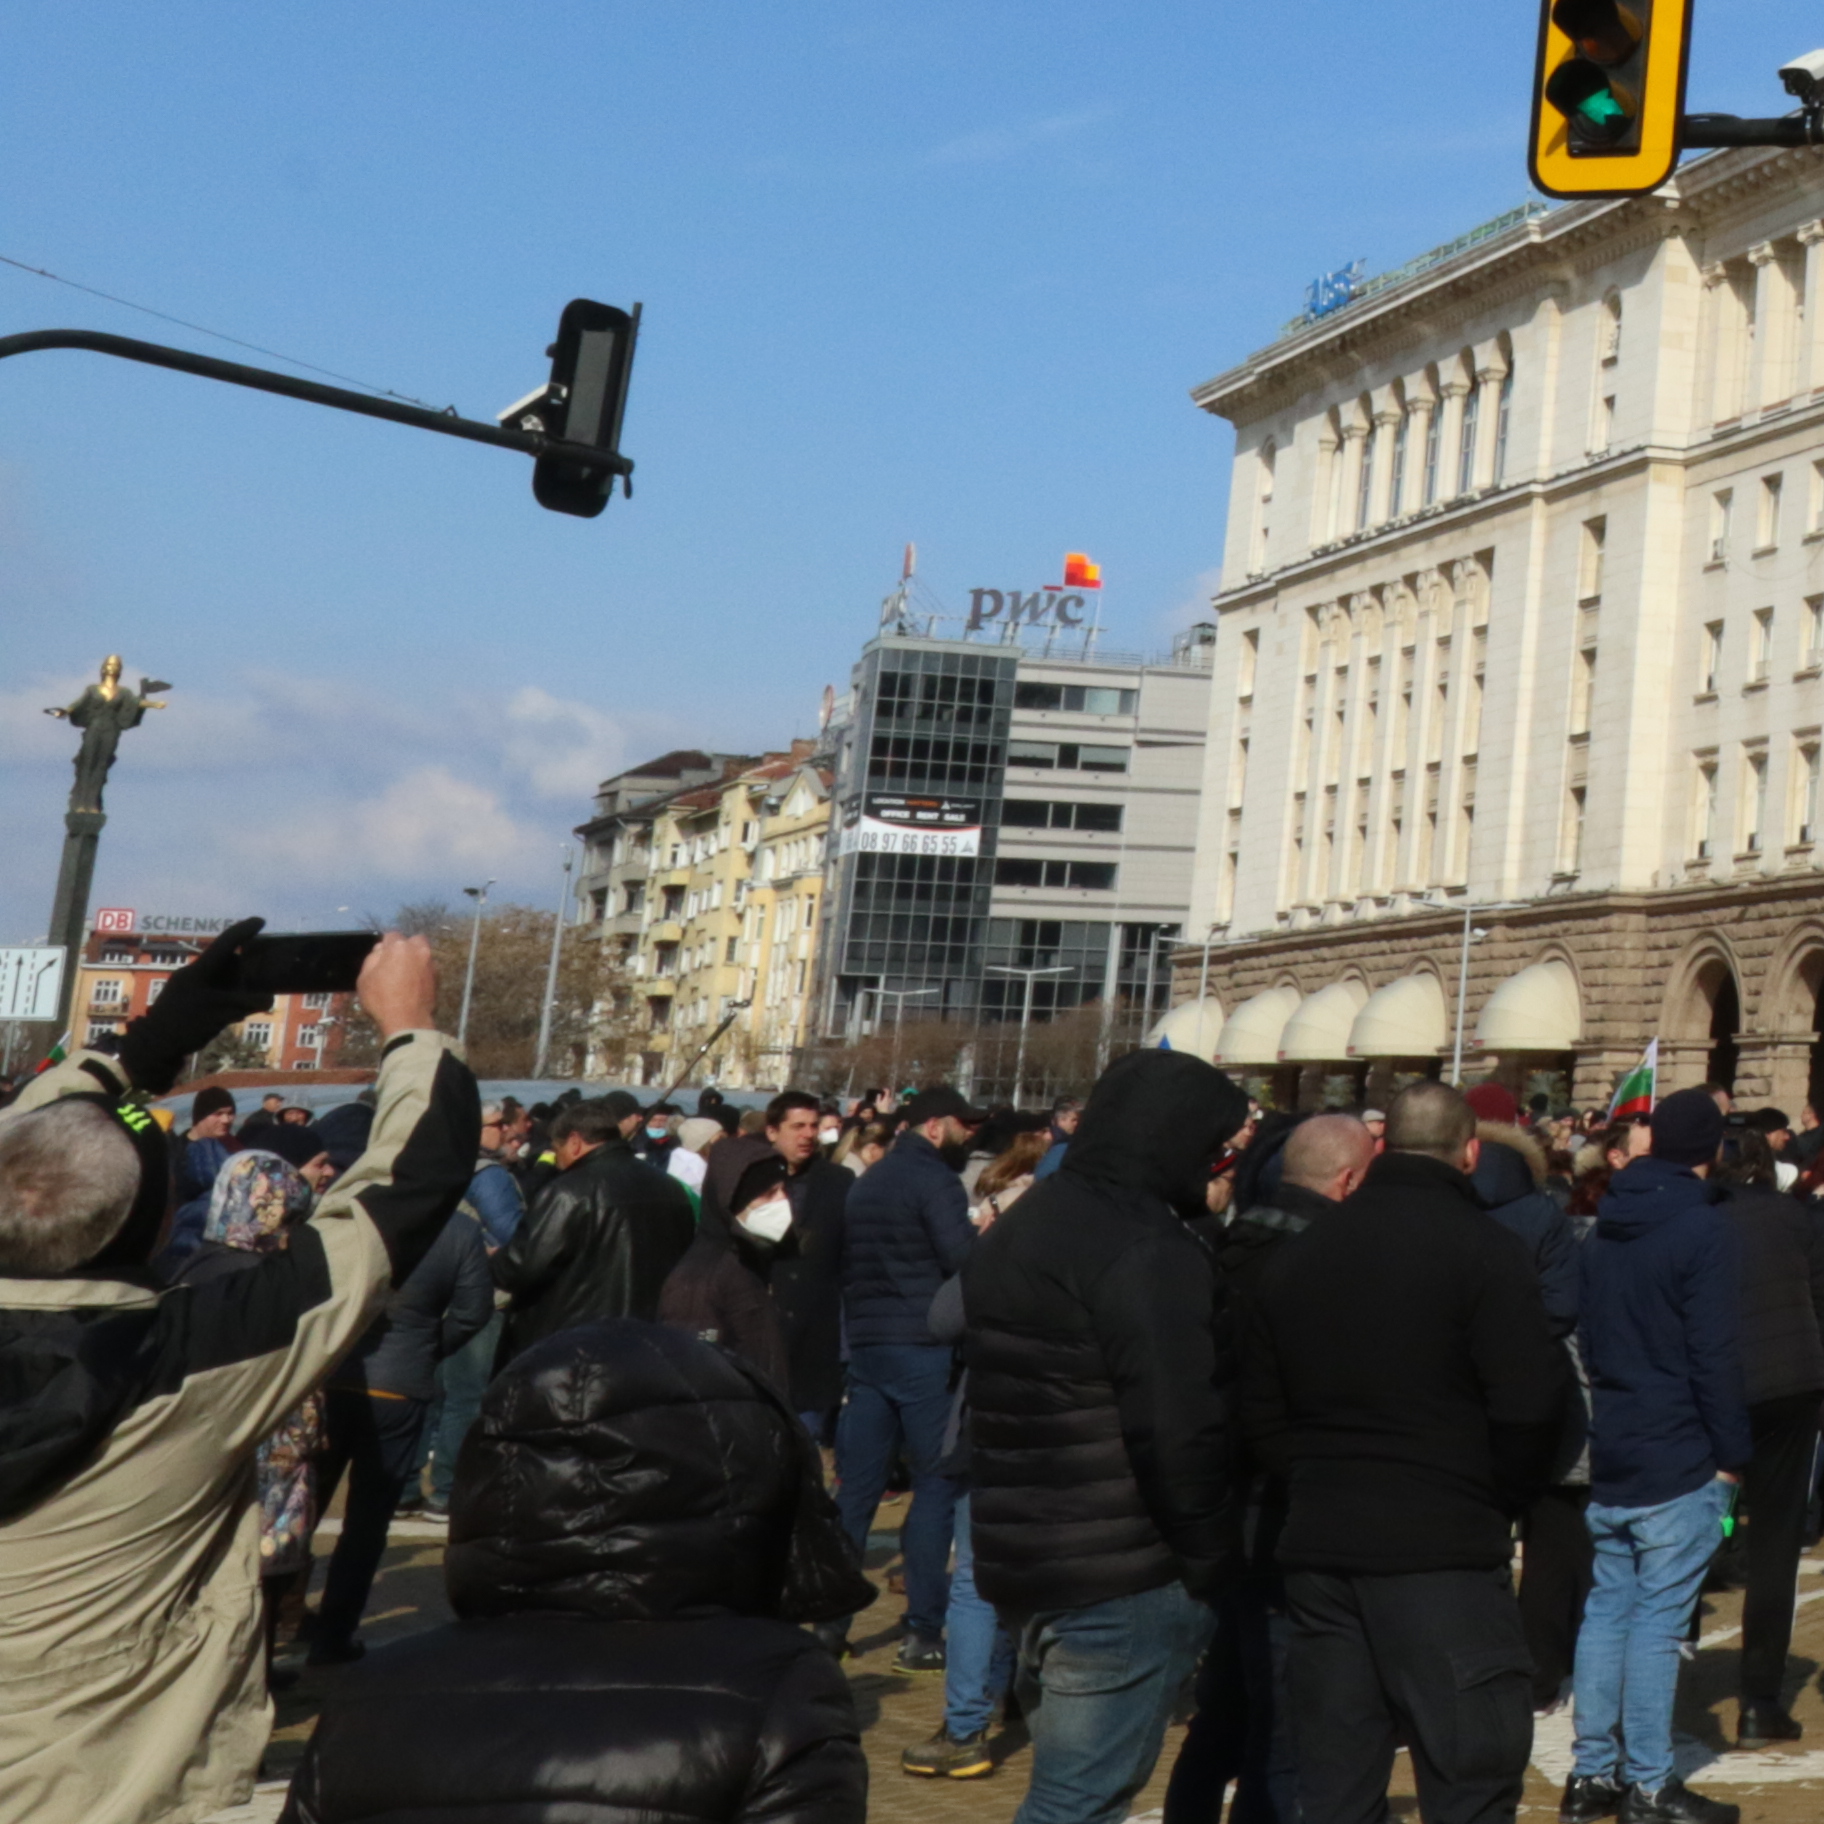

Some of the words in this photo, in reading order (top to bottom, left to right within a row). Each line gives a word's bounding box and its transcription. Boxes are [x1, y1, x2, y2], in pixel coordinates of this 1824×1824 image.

[968, 588, 1085, 631] pwc
[861, 832, 878, 850] 08
[882, 833, 898, 851] 97
[902, 834, 918, 852] 66
[922, 835, 938, 854] 65
[941, 836, 957, 855] 55
[101, 912, 130, 928] DB
[141, 915, 236, 933] SCHENKE
